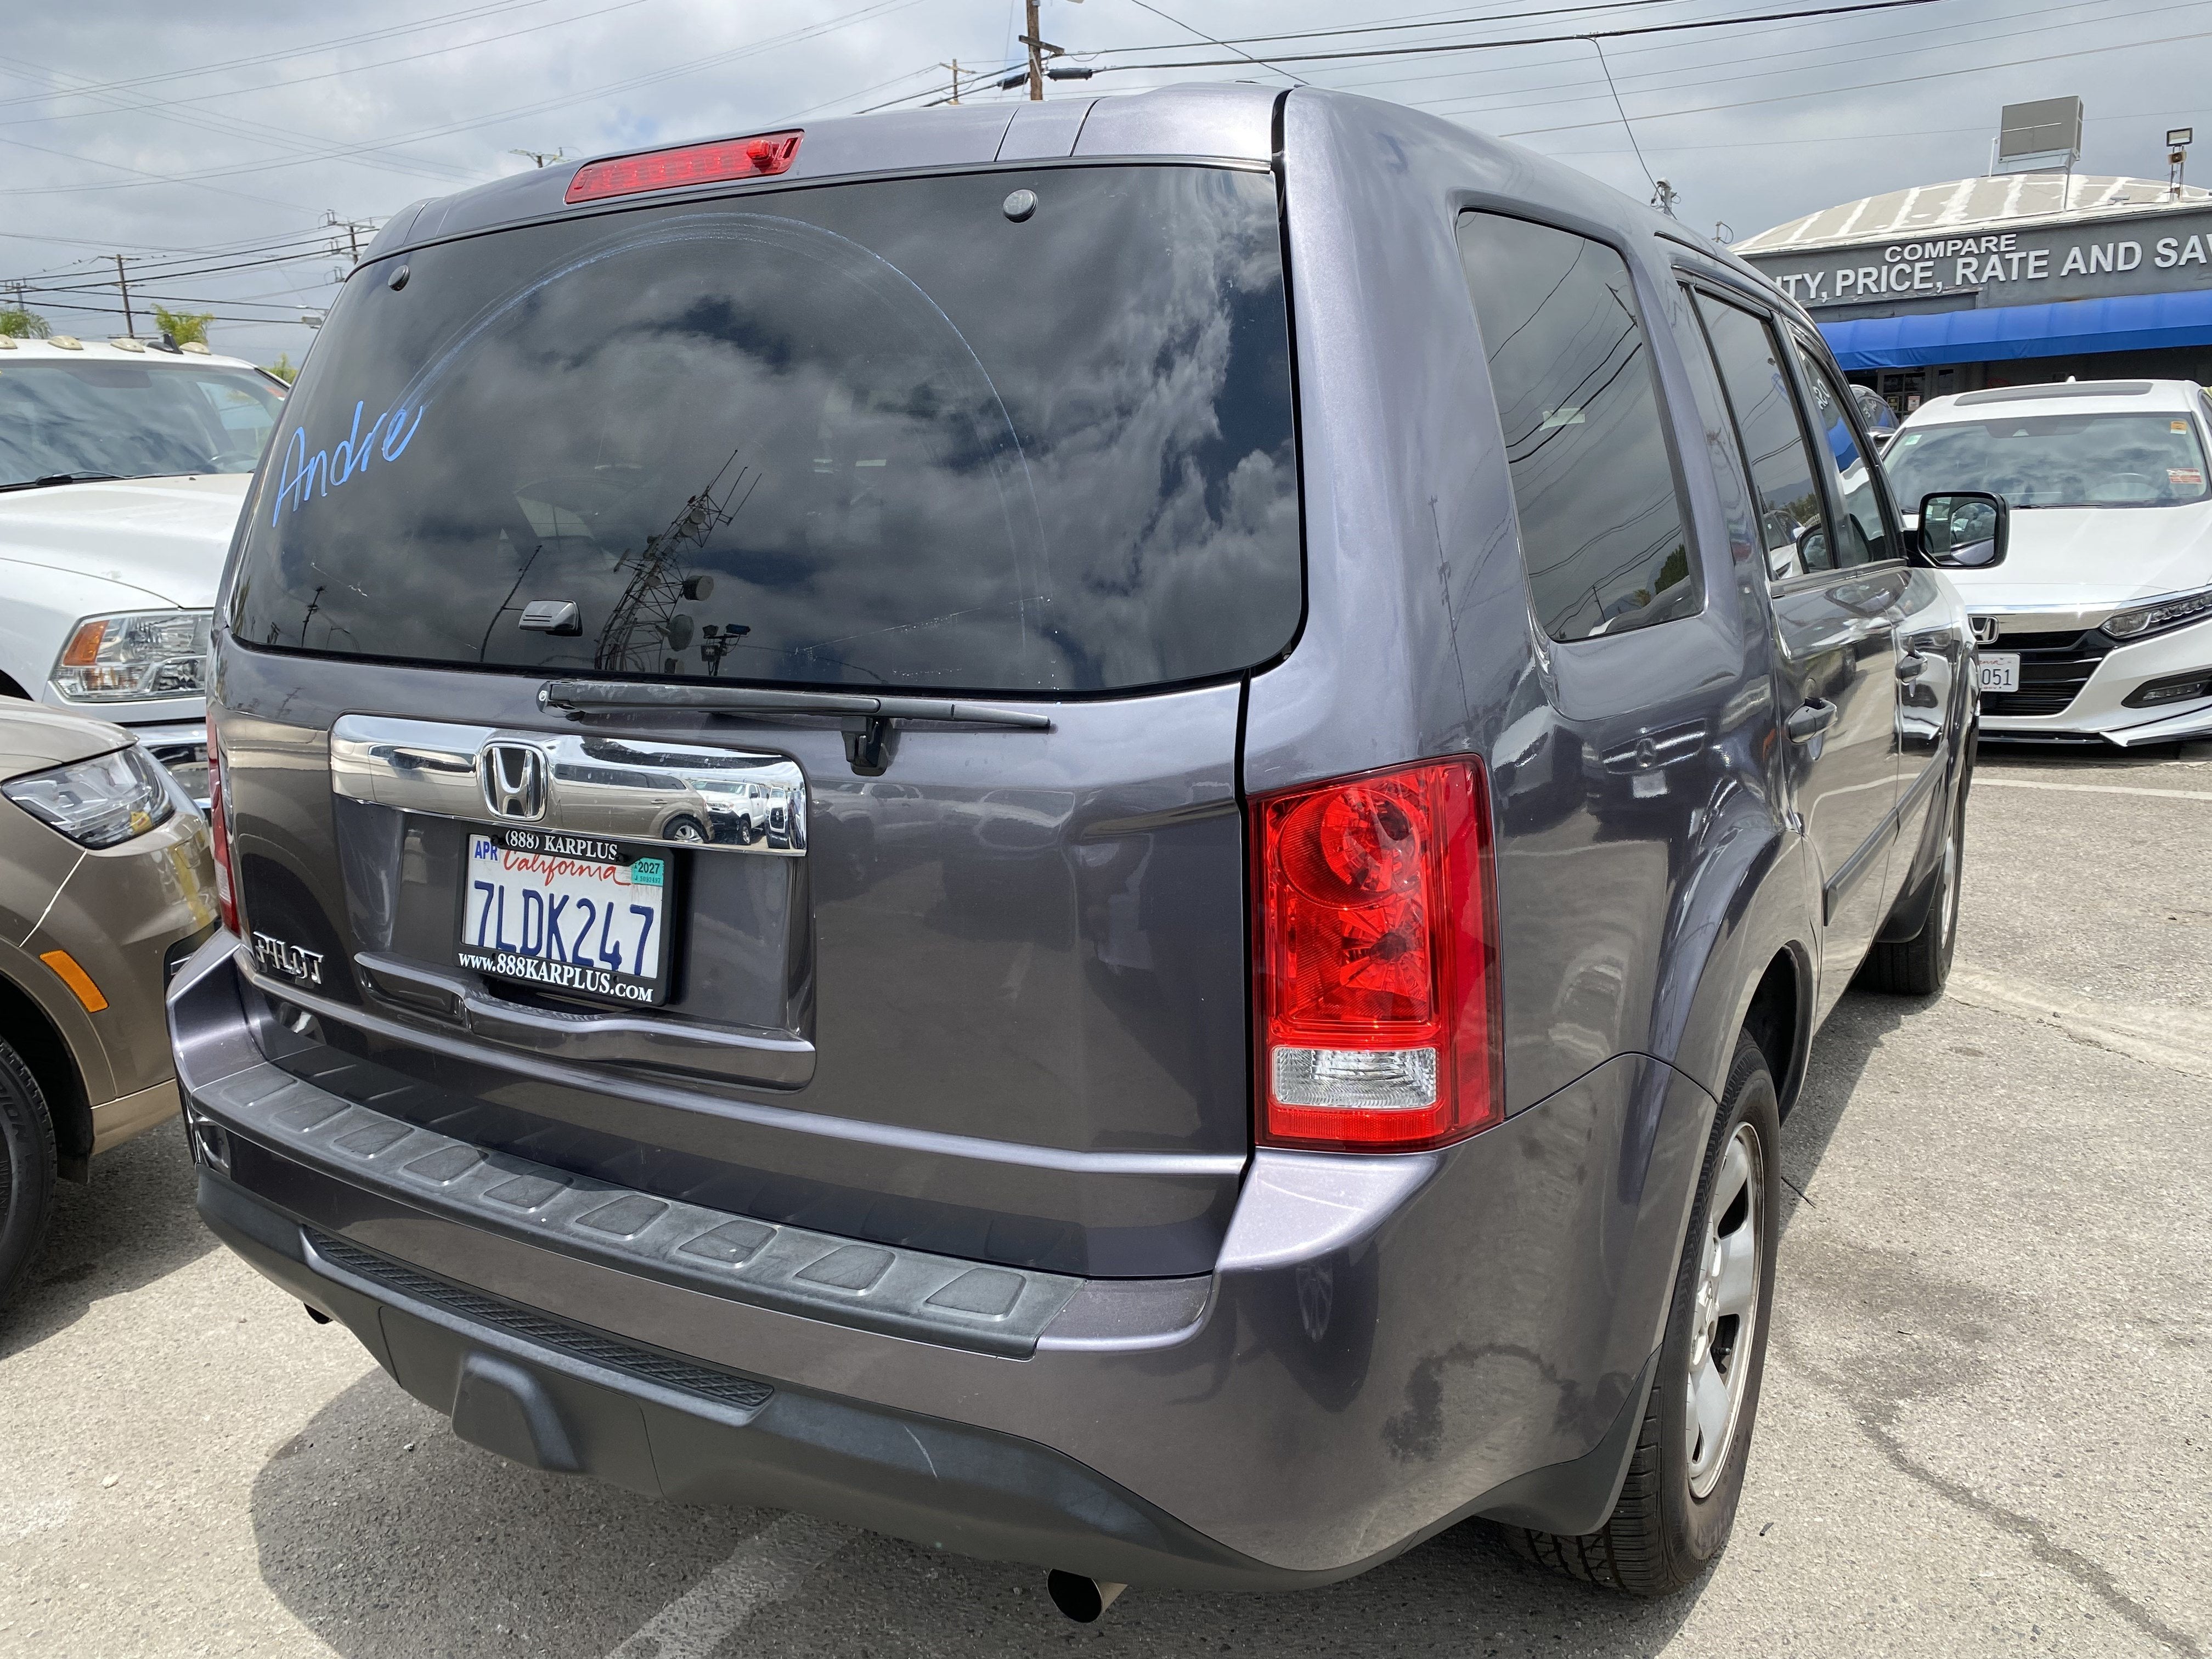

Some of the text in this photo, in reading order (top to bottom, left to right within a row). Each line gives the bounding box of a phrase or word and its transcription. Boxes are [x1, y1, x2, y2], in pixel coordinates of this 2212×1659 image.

[1836, 261, 1943, 297] PRICE,
[1956, 249, 2050, 285] RATE
[2059, 241, 2142, 276] AND
[2154, 233, 2212, 268] SA
[1885, 233, 2017, 263] COMPARE
[272, 400, 423, 528] Andre
[475, 840, 498, 861] APR
[505, 830, 618, 861] (888) KARPLUS
[504, 850, 631, 887] California
[638, 862, 660, 874] 2027
[474, 880, 654, 975] 7LDK247
[253, 931, 324, 985] PILOT
[458, 952, 653, 1002] www.888KARPLUS.COM
